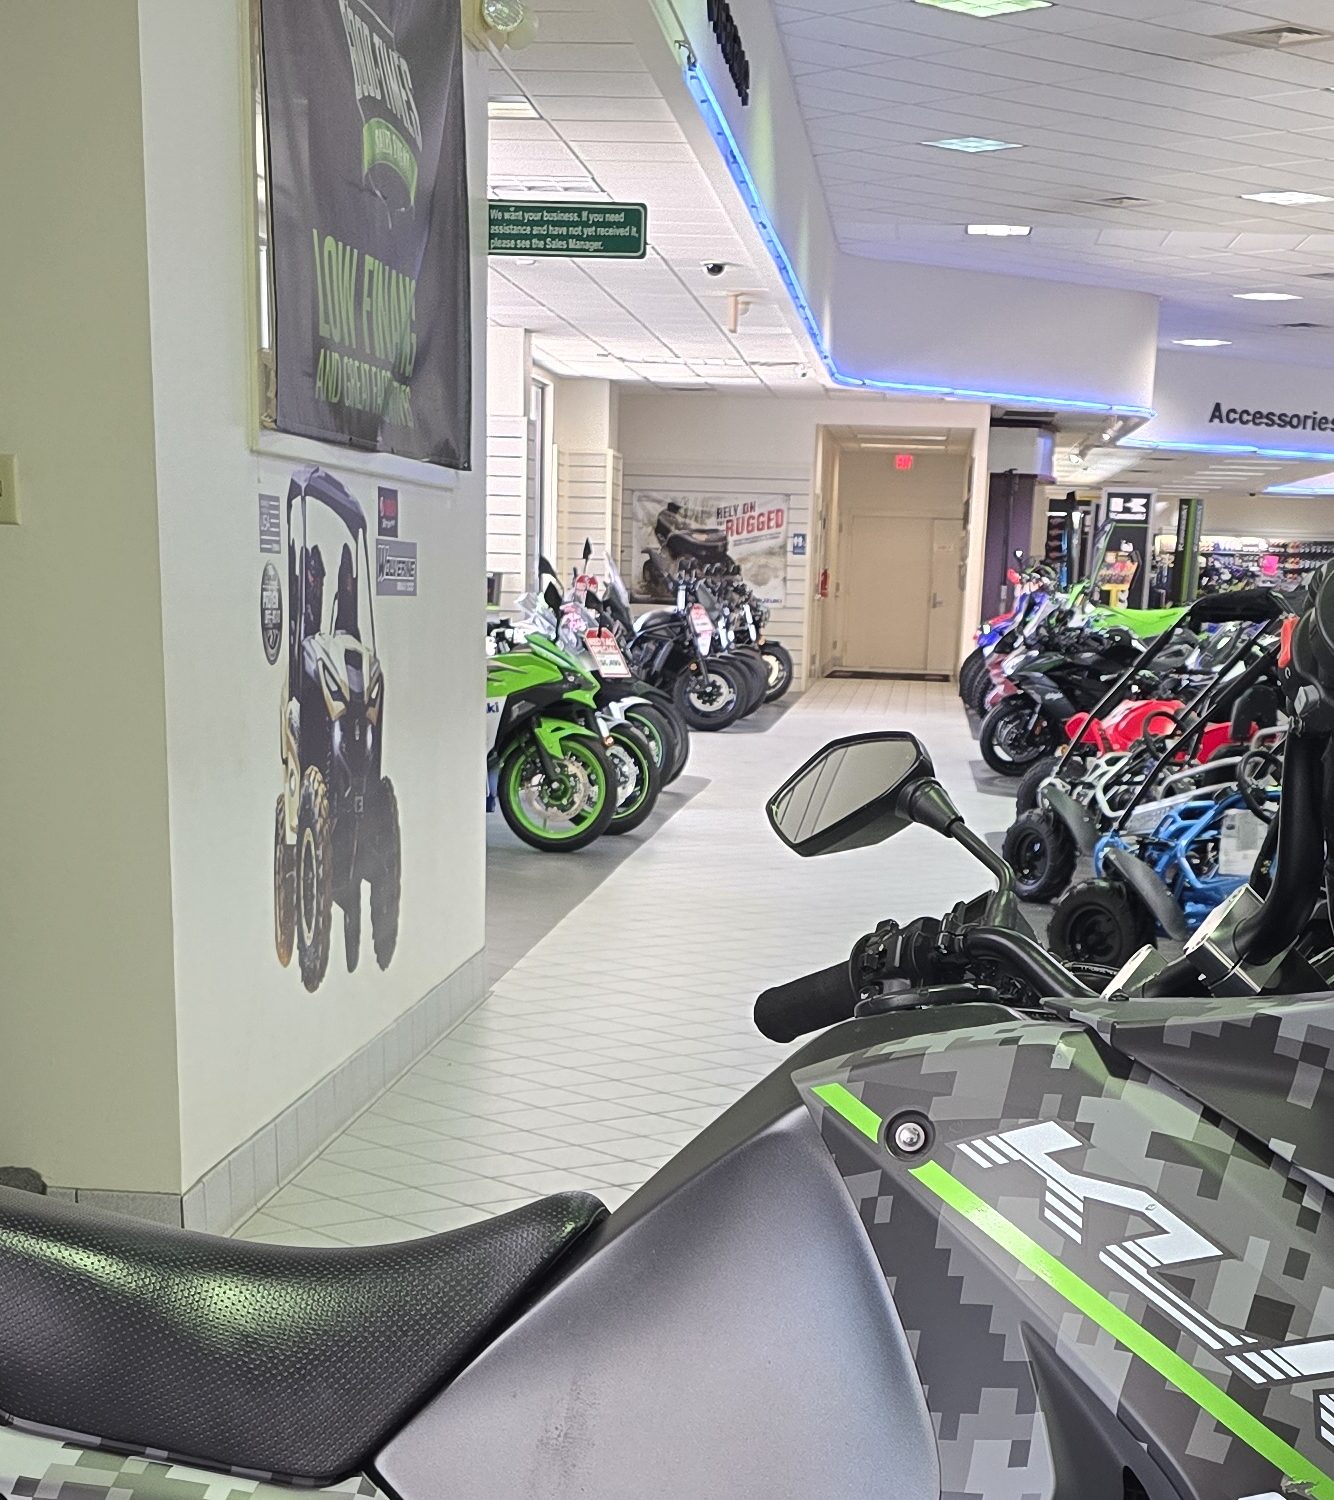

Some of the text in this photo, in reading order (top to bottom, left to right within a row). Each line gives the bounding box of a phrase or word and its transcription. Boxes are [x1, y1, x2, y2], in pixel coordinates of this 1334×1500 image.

[490, 209, 625, 224] We want your business. If you need
[490, 223, 639, 237] assistance and have not yet received it,
[490, 237, 604, 251] please see the Sales Manager.
[313, 228, 358, 349] LOW
[315, 348, 342, 403] AND
[717, 501, 756, 519] RELY ON
[725, 508, 785, 537] RUGGED
